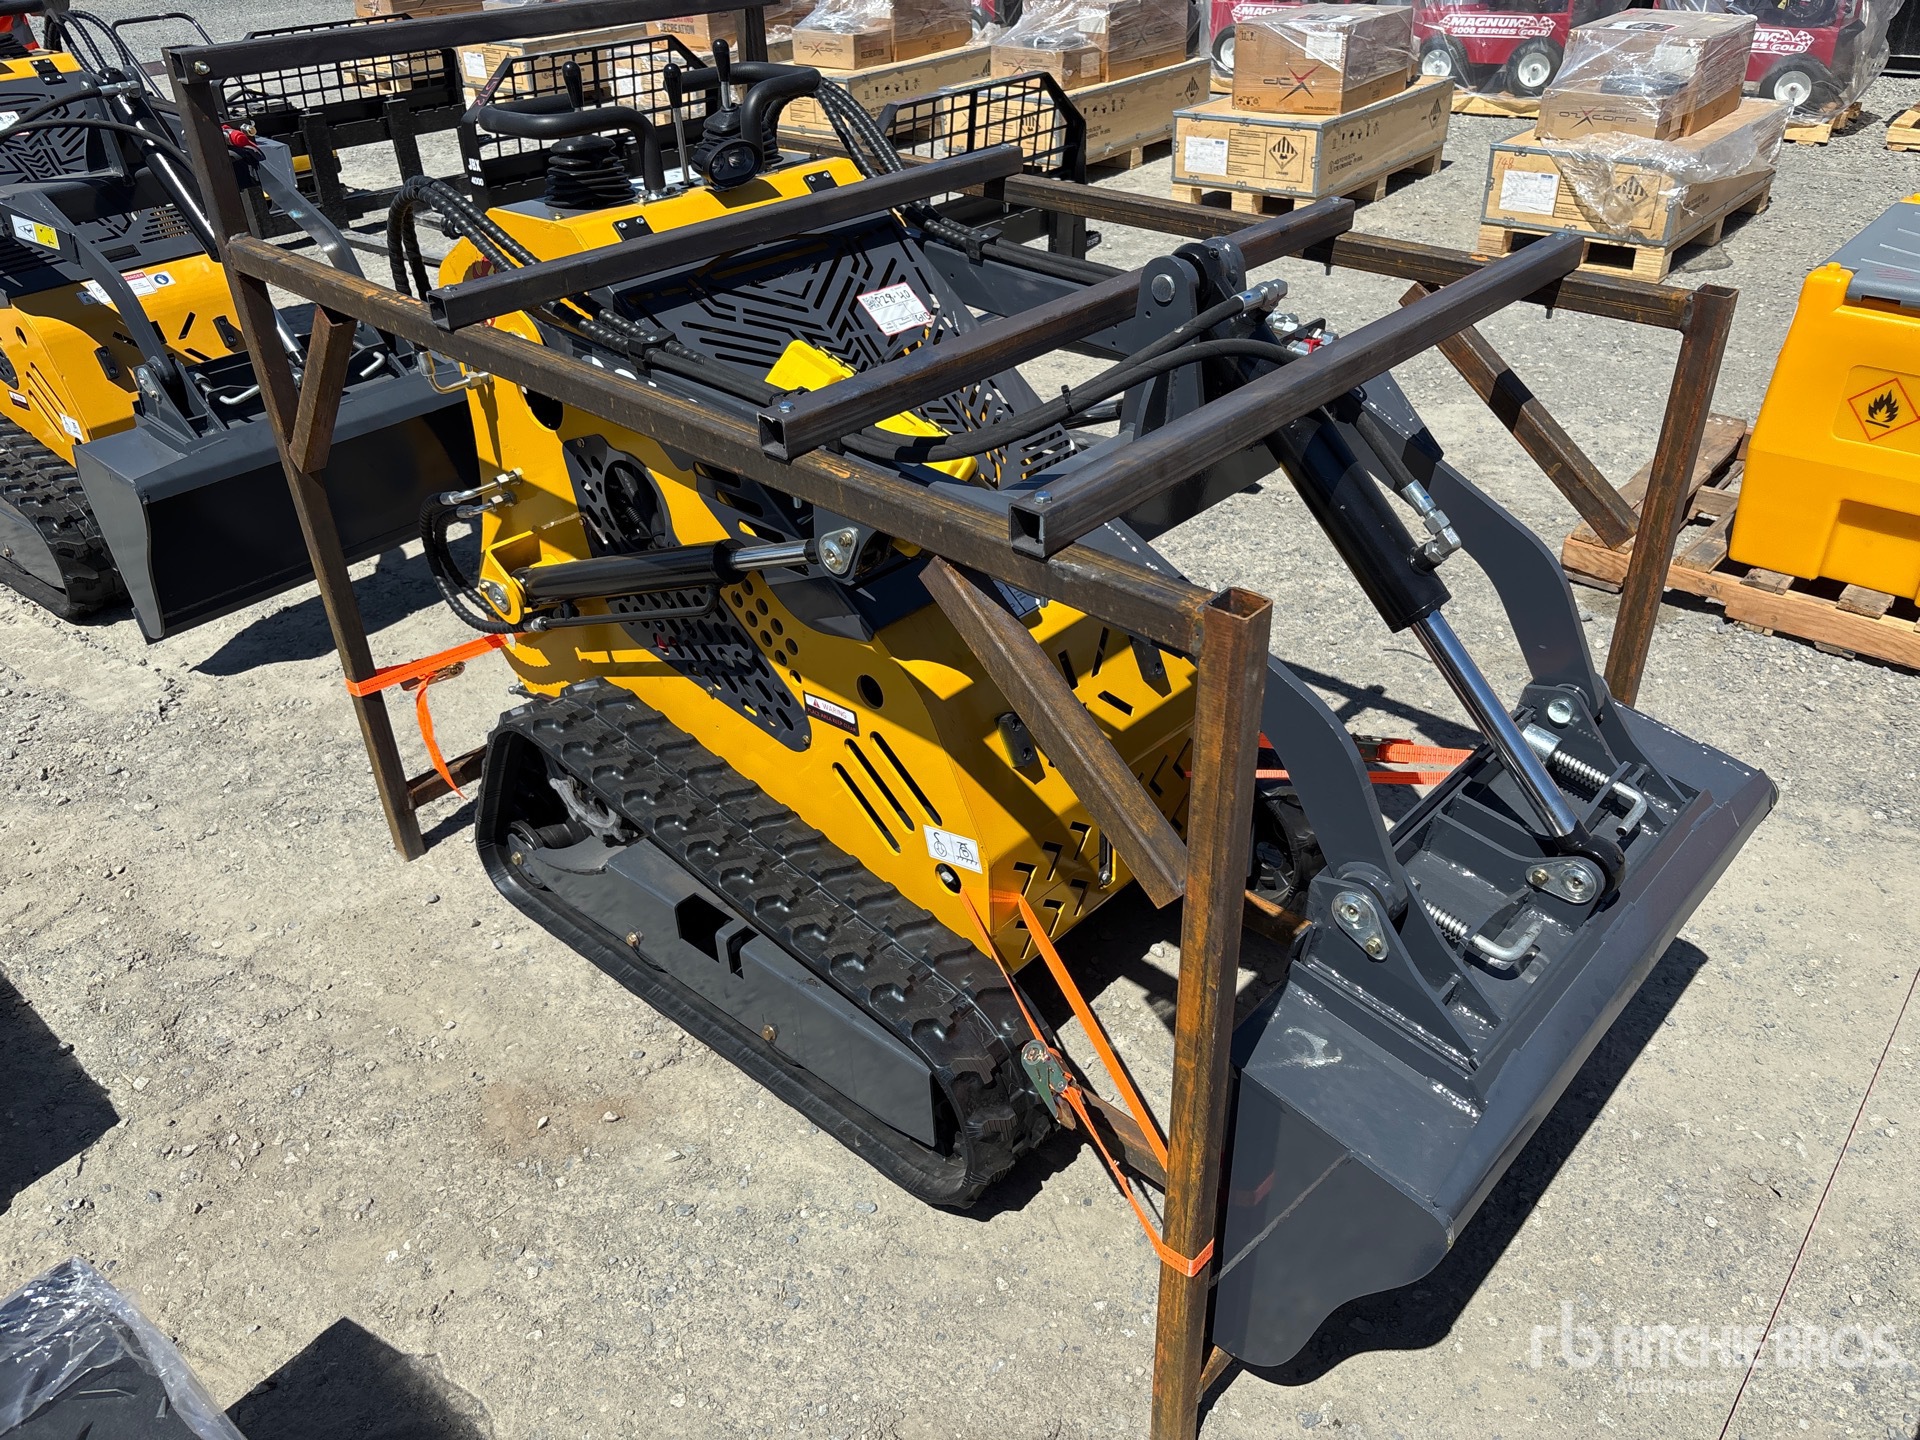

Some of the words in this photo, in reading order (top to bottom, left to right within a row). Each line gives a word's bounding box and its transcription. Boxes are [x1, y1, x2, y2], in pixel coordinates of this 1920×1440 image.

[1450, 17, 1522, 27] MAGNUM
[1451, 27, 1476, 35] 4000
[1771, 43, 1805, 52] GOLD
[468, 157, 482, 172] JBX
[822, 702, 847, 719] WARING
